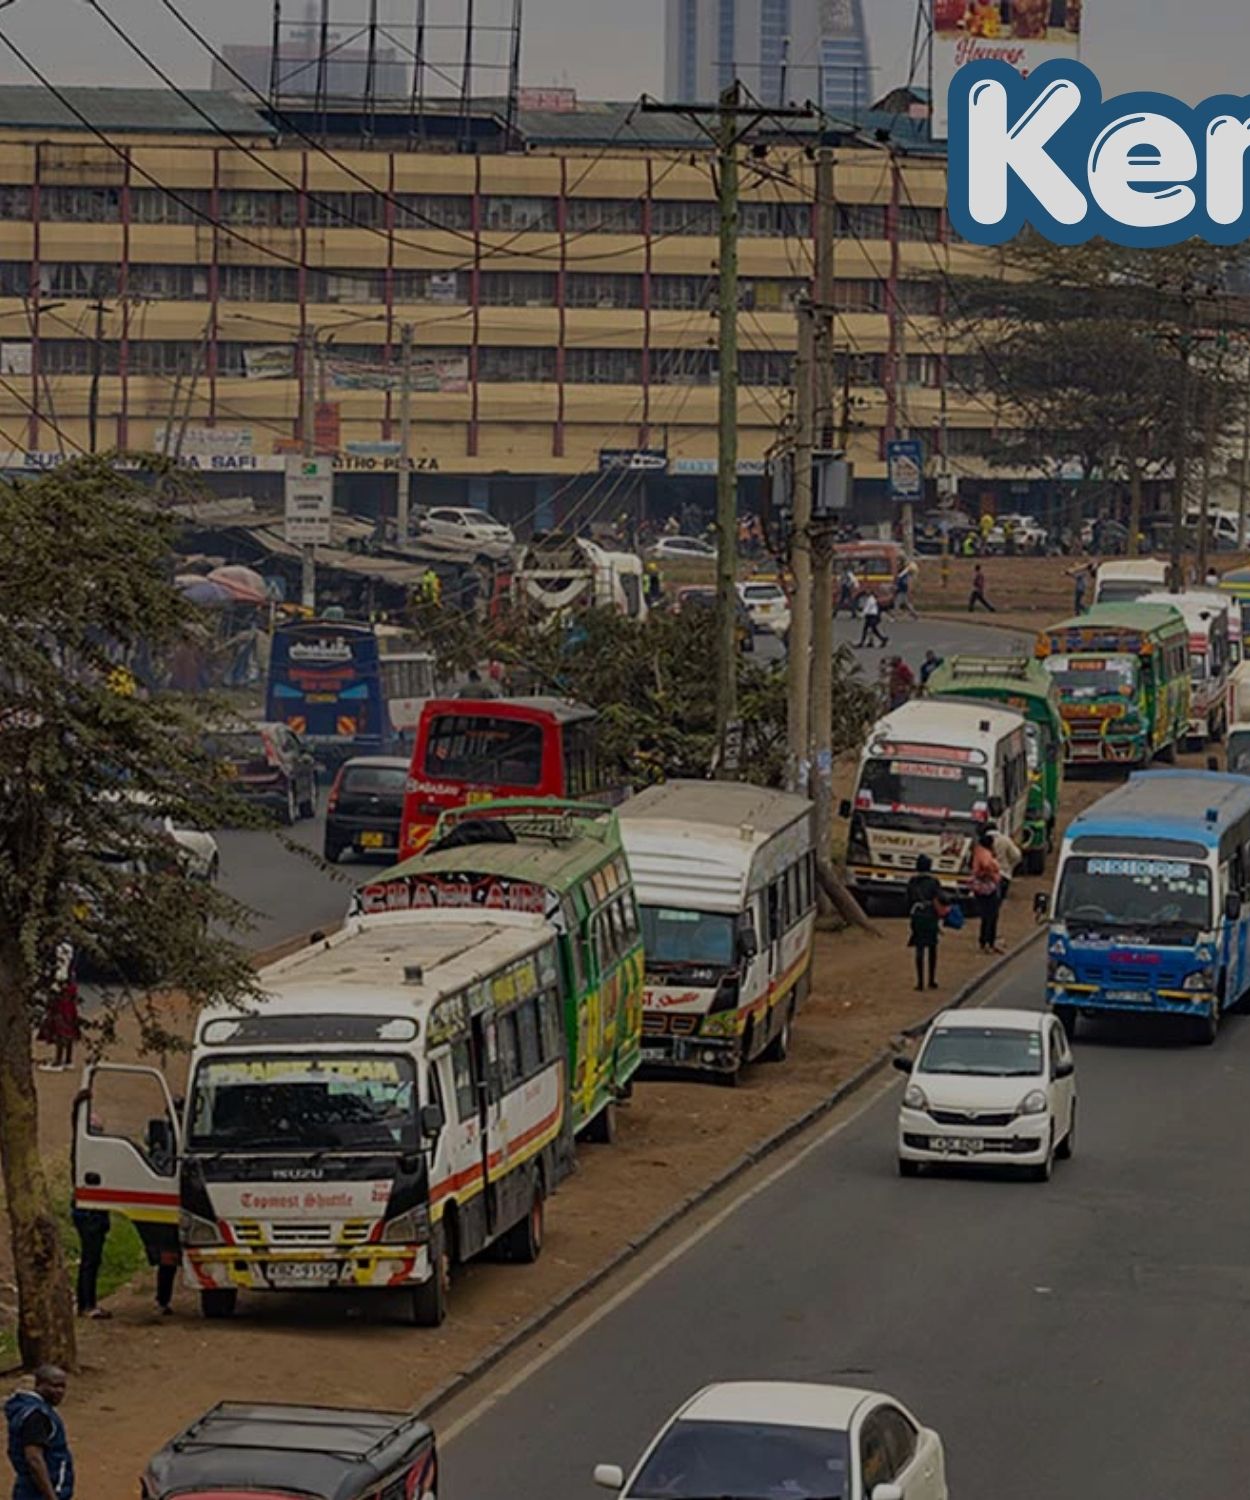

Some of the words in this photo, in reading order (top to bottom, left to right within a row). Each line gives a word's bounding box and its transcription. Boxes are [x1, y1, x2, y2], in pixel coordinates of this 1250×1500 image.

[272, 1169, 324, 1179] ISUZU
[241, 1193, 299, 1208] Topmost
[303, 1193, 353, 1207] Shuttle
